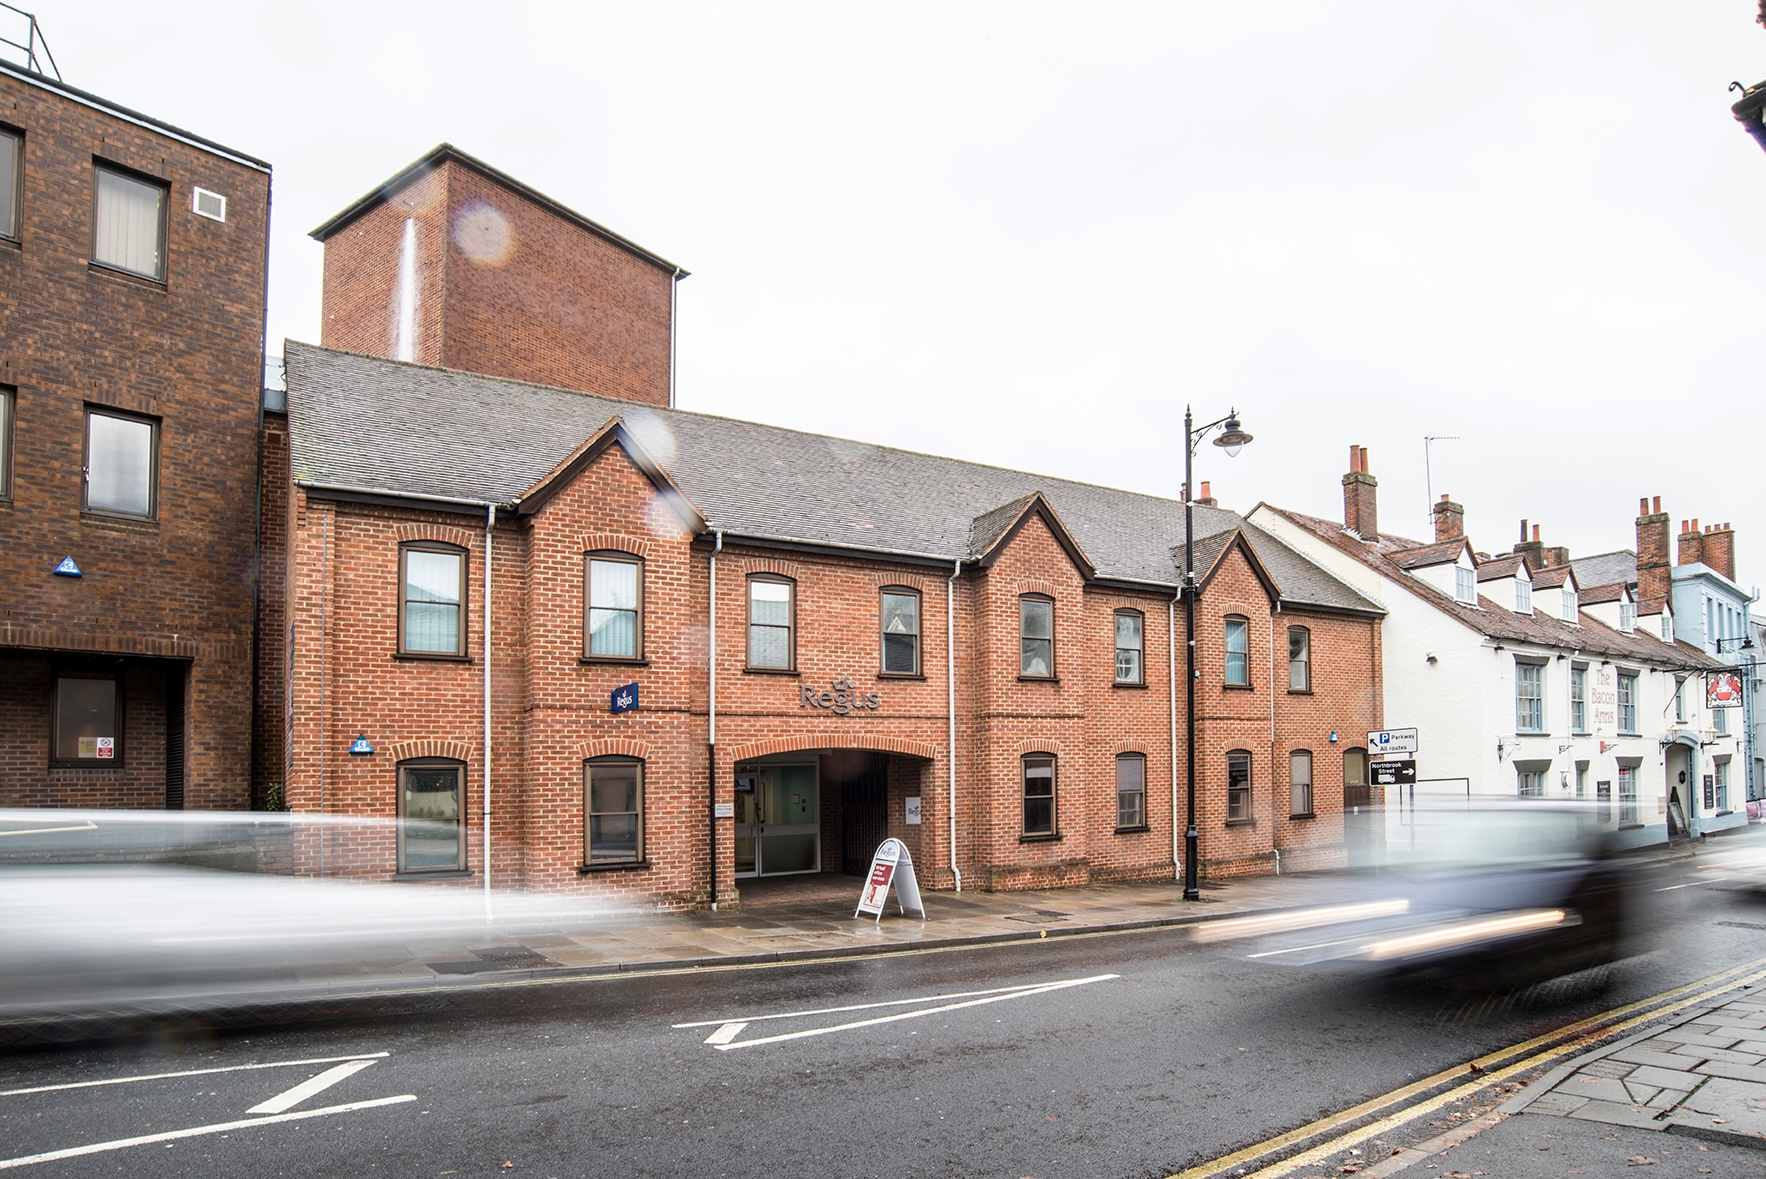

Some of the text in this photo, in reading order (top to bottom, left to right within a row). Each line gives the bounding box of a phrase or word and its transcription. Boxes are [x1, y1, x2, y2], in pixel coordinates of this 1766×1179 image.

[1595, 669, 1610, 686] The
[616, 695, 633, 709] Regus
[800, 685, 880, 715] Regus
[1591, 688, 1615, 705] Bacon
[1594, 707, 1614, 724] Arms
[1371, 761, 1402, 769] Northbrook
